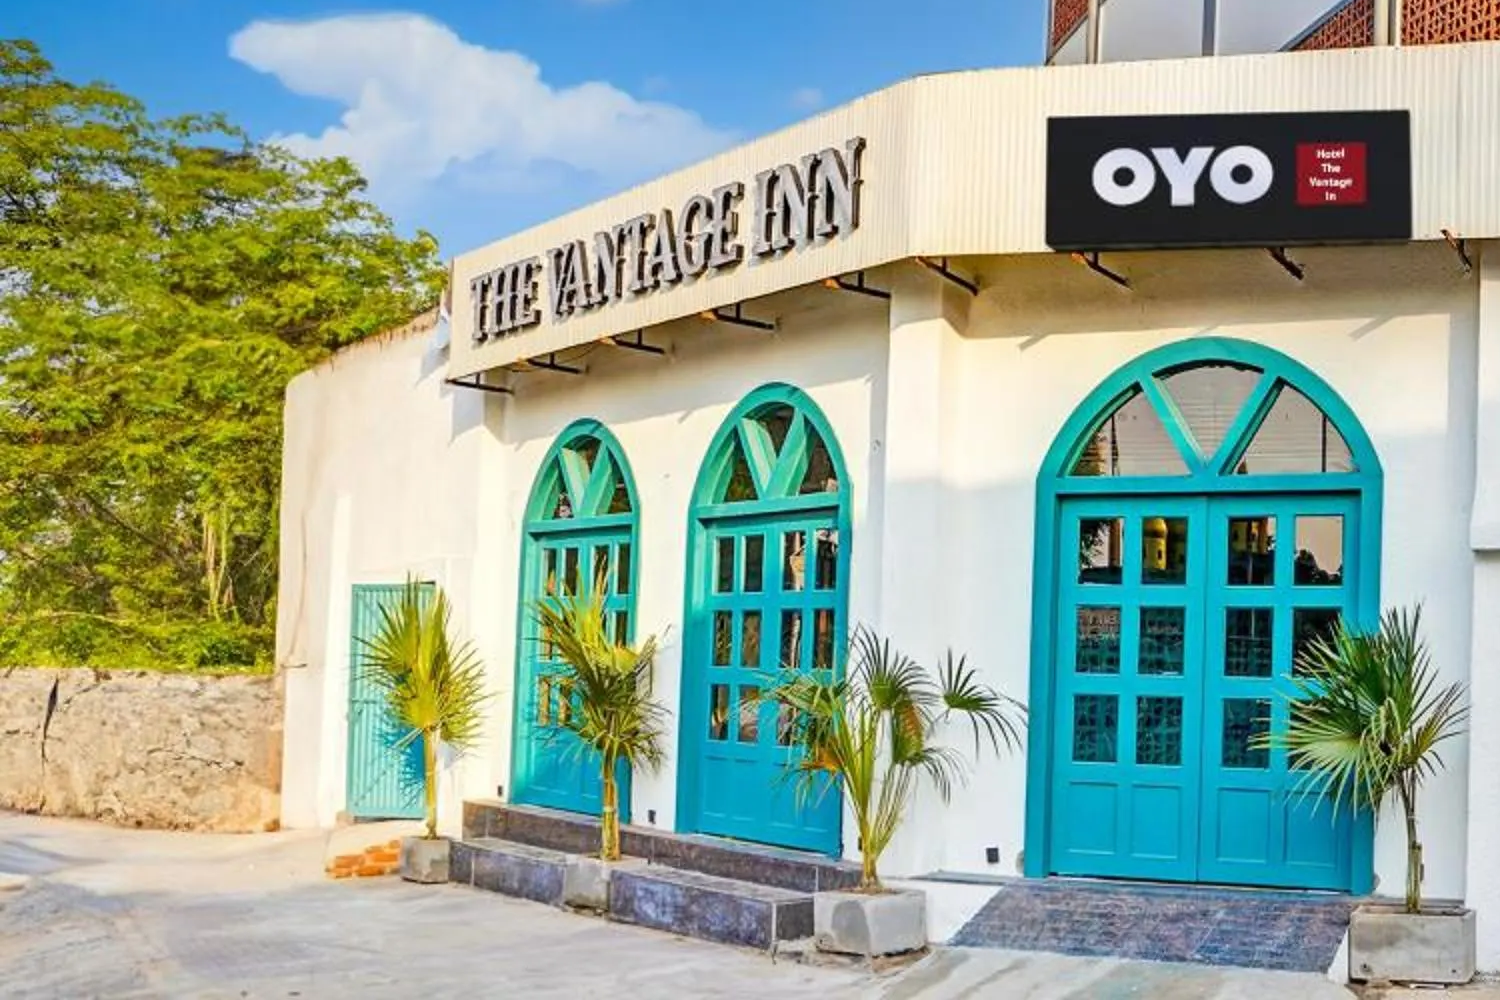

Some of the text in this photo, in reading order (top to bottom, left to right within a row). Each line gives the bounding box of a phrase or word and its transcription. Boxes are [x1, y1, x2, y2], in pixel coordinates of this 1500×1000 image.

[1316, 147, 1345, 159] Hotel
[1321, 162, 1341, 173] The
[1092, 145, 1273, 206] OYO
[1309, 176, 1353, 189] Vantage
[1325, 191, 1337, 201] In
[471, 136, 867, 341] THE VANTAGE INN
